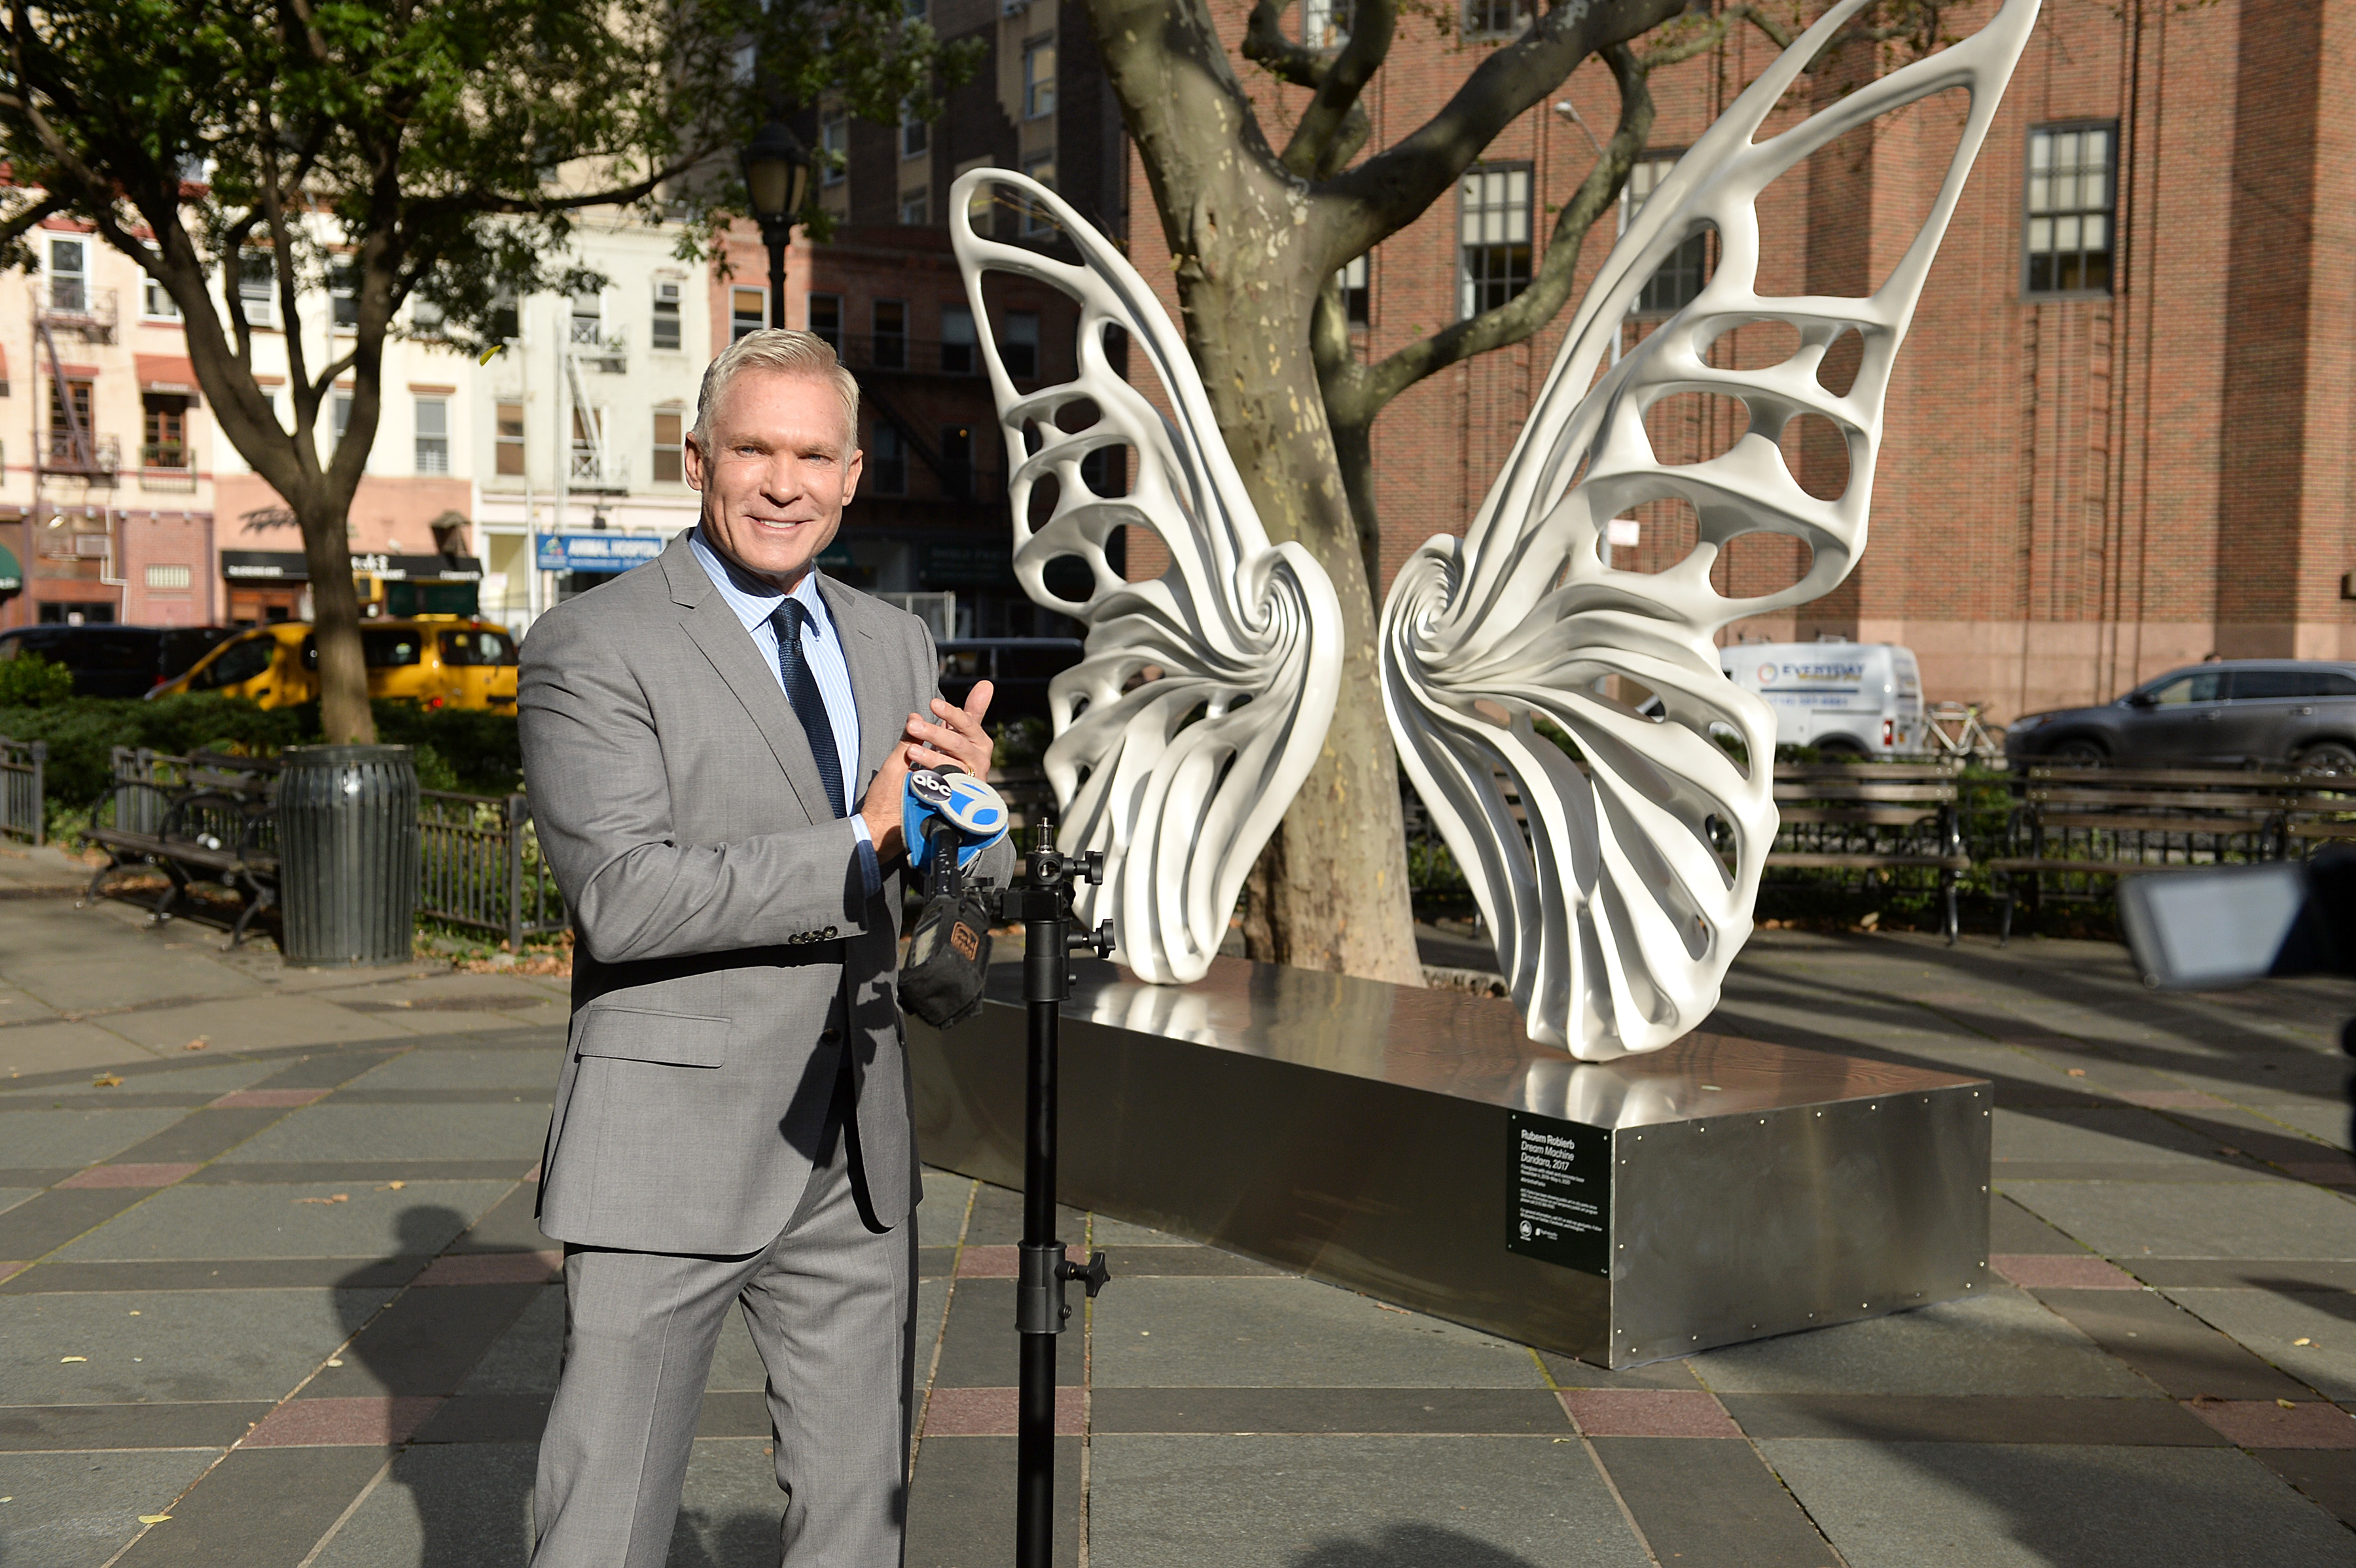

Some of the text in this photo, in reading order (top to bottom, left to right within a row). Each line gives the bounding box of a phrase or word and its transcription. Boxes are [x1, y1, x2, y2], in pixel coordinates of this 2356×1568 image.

[912, 774, 952, 797] abc
[1521, 1129, 1575, 1150] Rubem Robierb
[1520, 1141, 1575, 1162] Dream Machine
[1552, 1159, 1570, 1171] 2017
